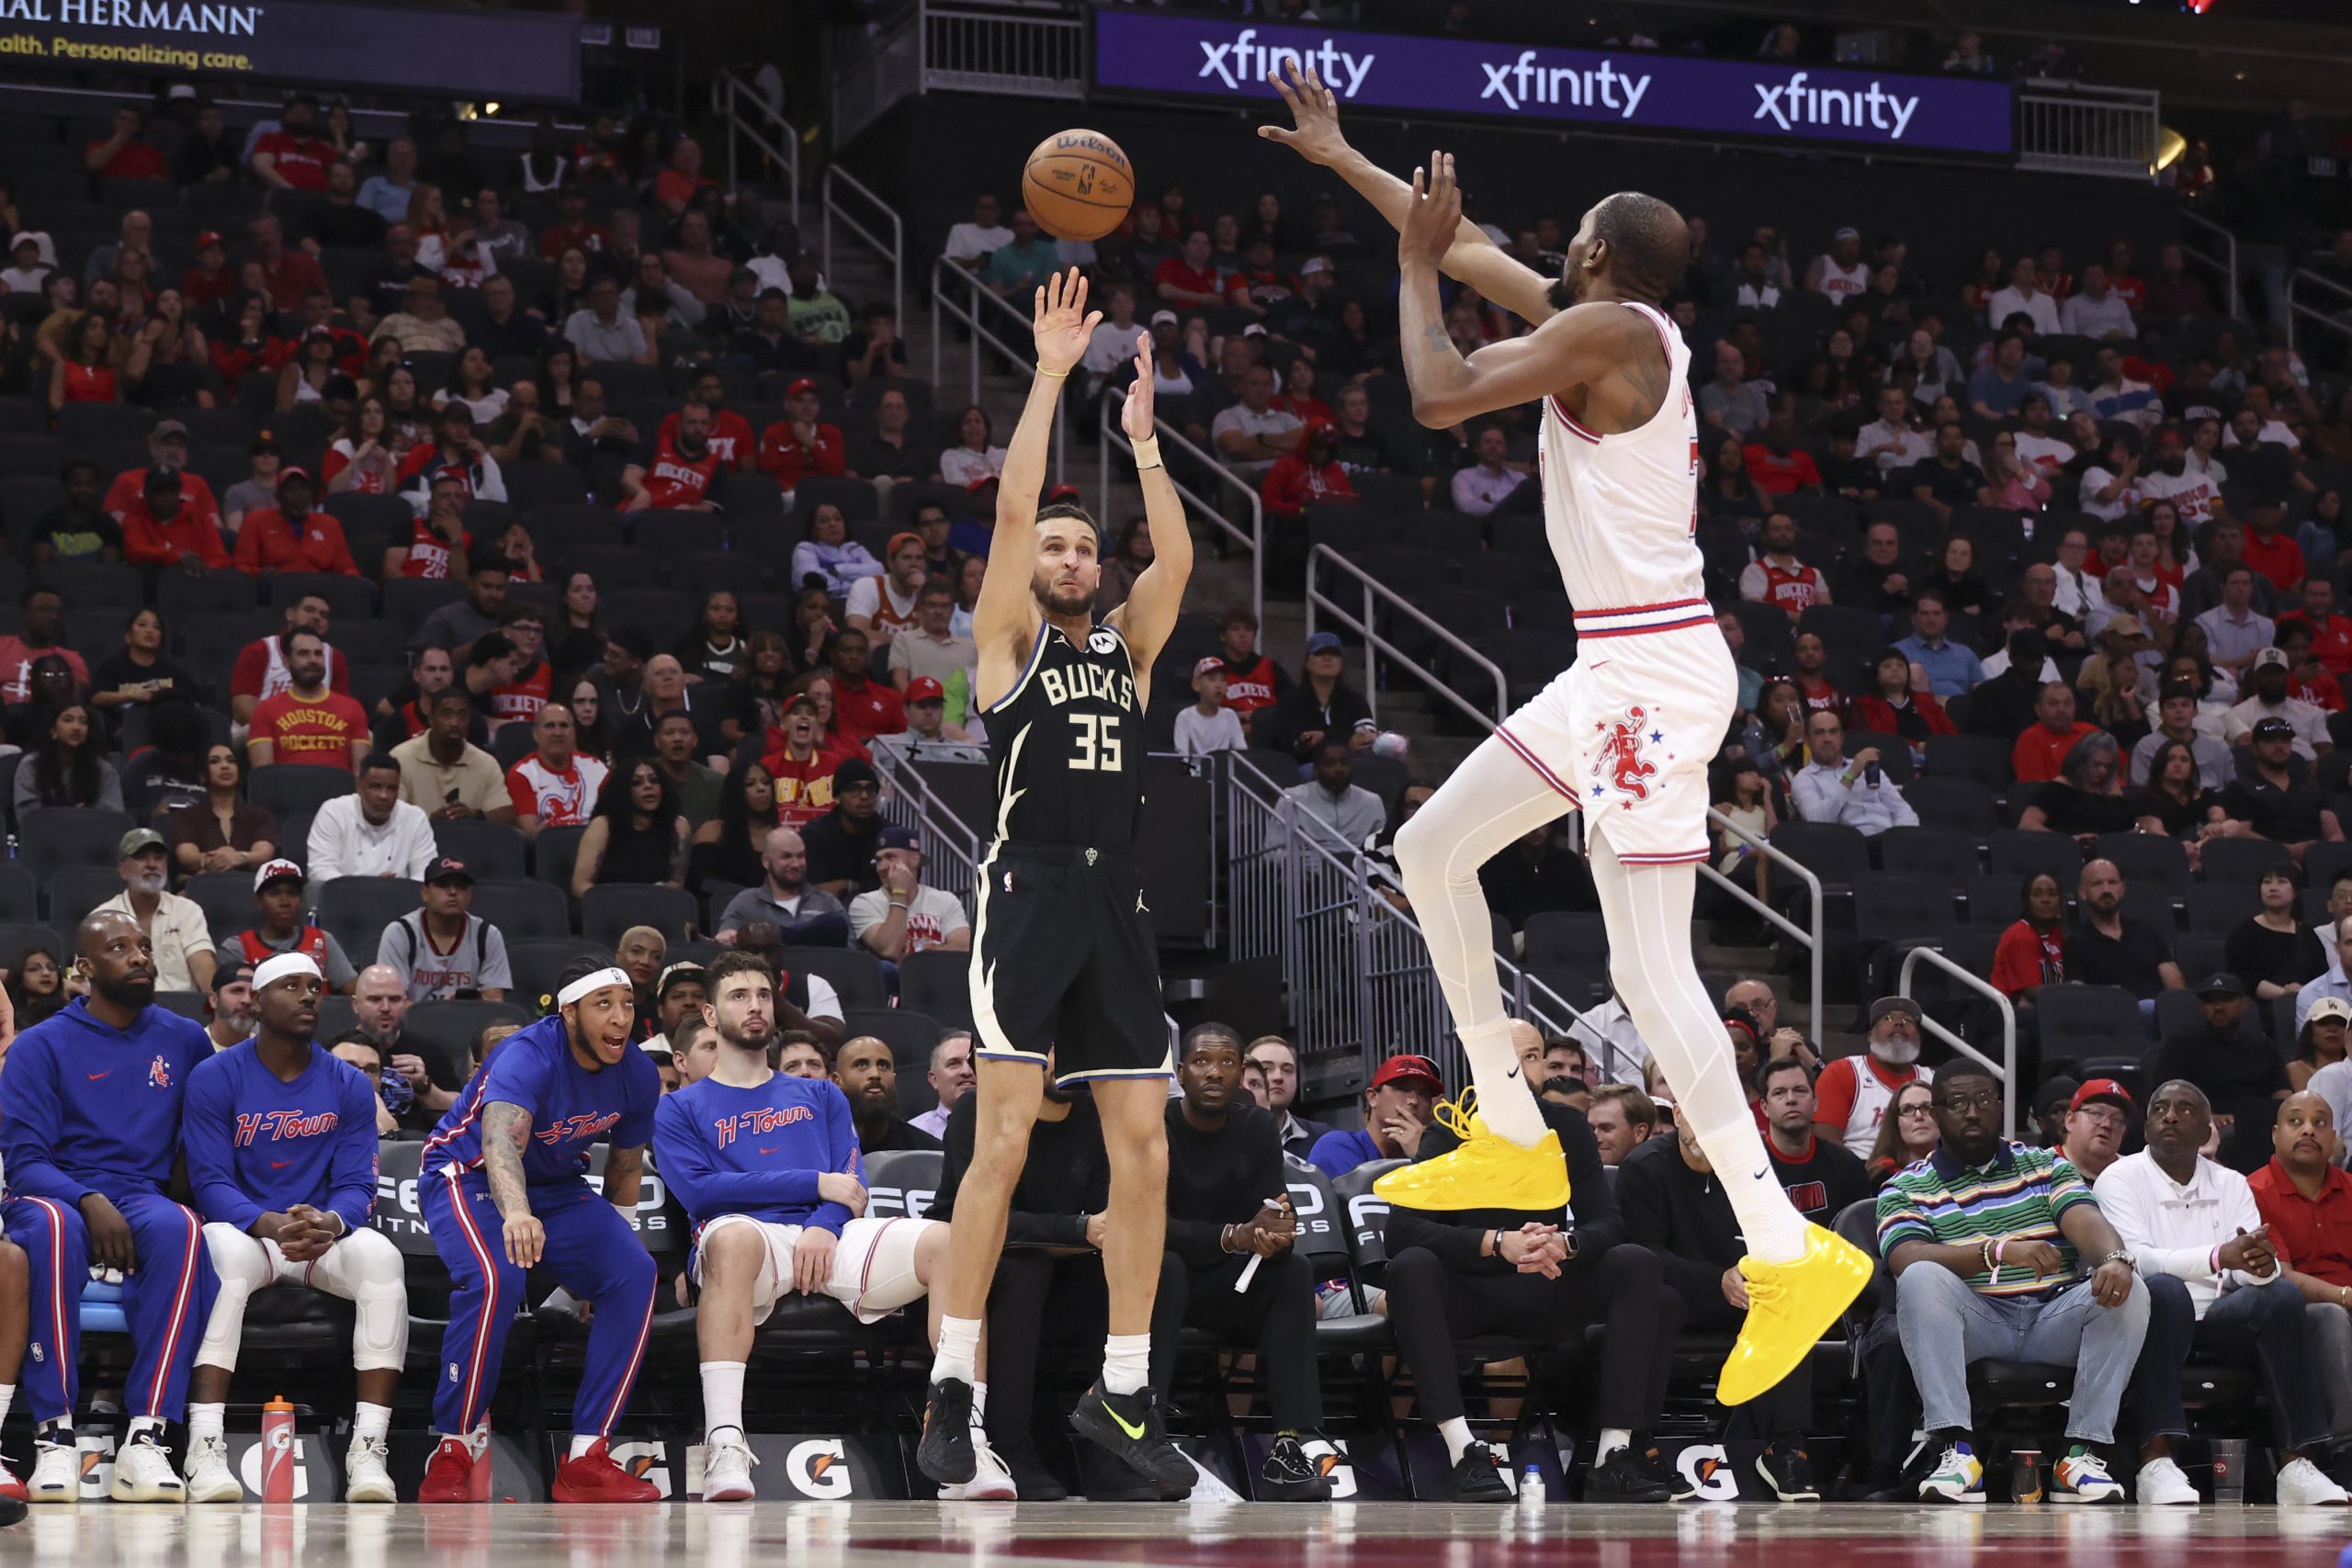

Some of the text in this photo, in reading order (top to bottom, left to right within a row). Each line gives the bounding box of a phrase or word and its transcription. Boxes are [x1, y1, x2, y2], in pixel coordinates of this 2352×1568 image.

[59, 0, 256, 37] HERMANN
[52, 37, 198, 71] Personalizing
[202, 51, 253, 71] care.
[1199, 28, 1374, 96] xfinity
[1480, 51, 1650, 118] xfinity
[1754, 72, 1918, 139] xfinity
[1057, 134, 1125, 168] Wilson
[1039, 662, 1133, 710] BUCKS
[275, 708, 348, 732] HOUSTON
[279, 734, 347, 751] ROCKETS
[1069, 714, 1123, 772] 35
[414, 968, 471, 987] ROCKETS
[234, 1109, 338, 1147] H-Town
[714, 1105, 814, 1150] H-Town
[786, 1438, 854, 1500] G
[1676, 1443, 1740, 1501] G
